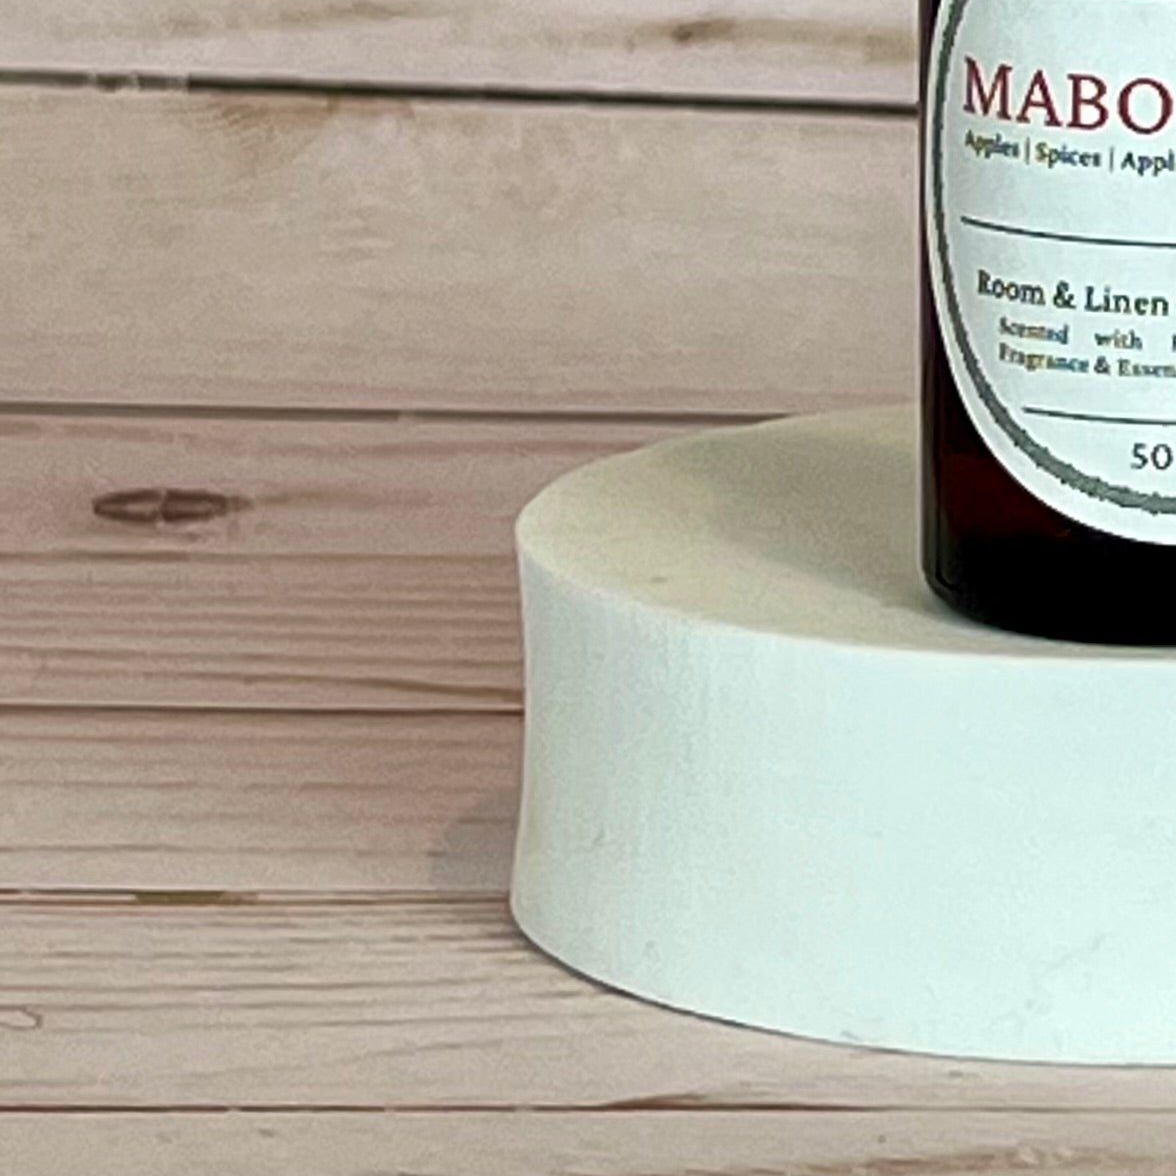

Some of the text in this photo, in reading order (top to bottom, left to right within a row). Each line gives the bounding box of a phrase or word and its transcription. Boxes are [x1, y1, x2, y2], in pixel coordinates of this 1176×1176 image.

[964, 129, 1019, 158] Apples
[1034, 142, 1101, 167] Spices
[978, 270, 1045, 306] Room
[1052, 281, 1077, 310] &
[1084, 285, 1170, 317] Linen
[1094, 329, 1143, 351] with
[998, 343, 1089, 373] Fragrance
[1131, 444, 1174, 471] 50
